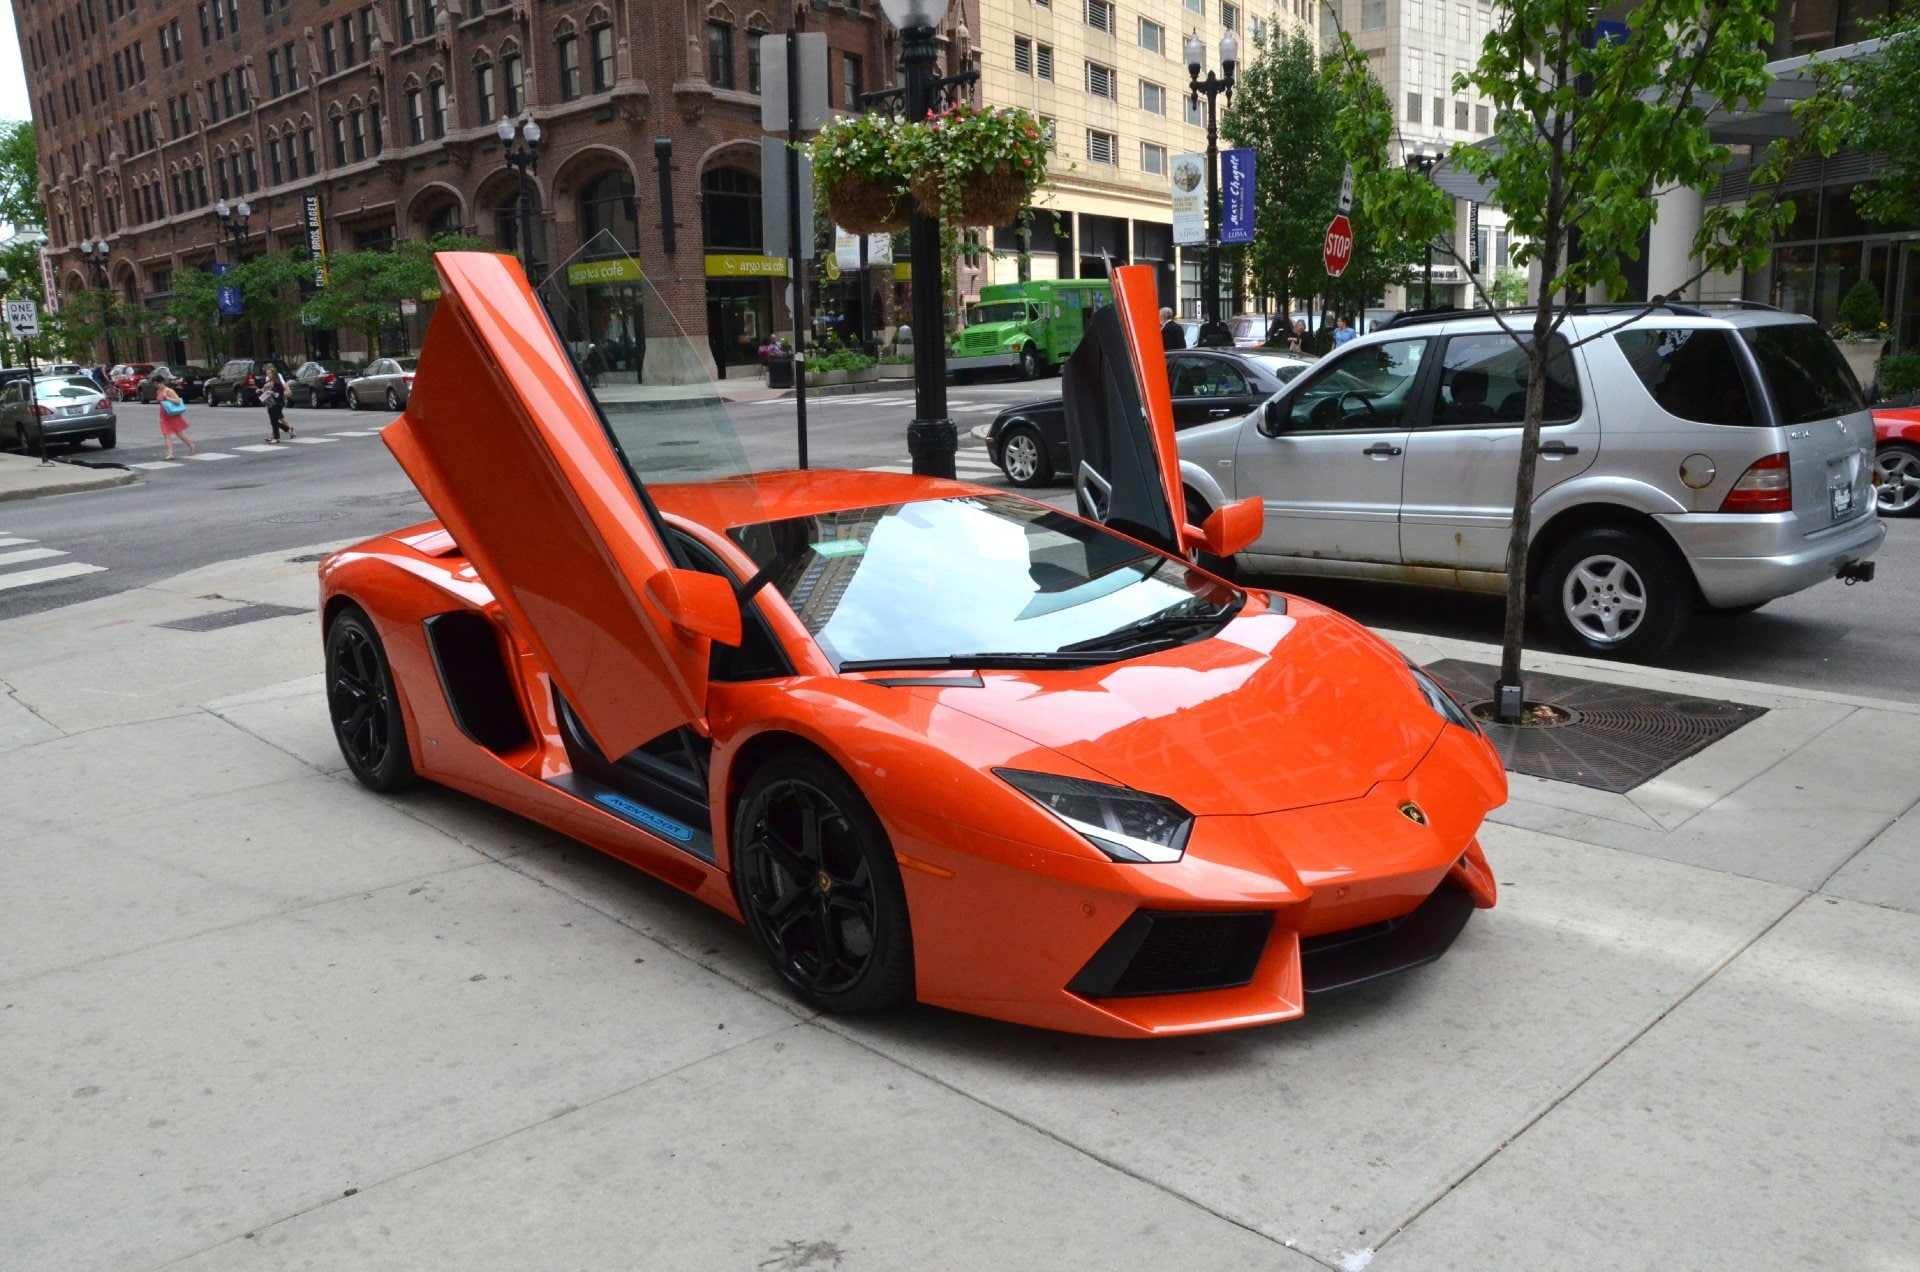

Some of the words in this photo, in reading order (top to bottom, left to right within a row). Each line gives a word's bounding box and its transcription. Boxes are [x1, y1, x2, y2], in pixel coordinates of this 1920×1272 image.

[1230, 155, 1245, 196] Chagall
[307, 197, 318, 227] BAGELS
[1230, 198, 1239, 226] Marc
[311, 229, 321, 250] BROS.
[1228, 230, 1247, 238] LUMA
[1326, 233, 1351, 258] STOP
[1470, 241, 1478, 262] rack
[313, 252, 325, 287] EINSTIN
[600, 260, 624, 277] café
[740, 261, 760, 273] argo
[761, 260, 772, 271] tea
[10, 303, 32, 312] ONE
[11, 313, 34, 322] WAY
[609, 798, 681, 834] AVENTADOR
